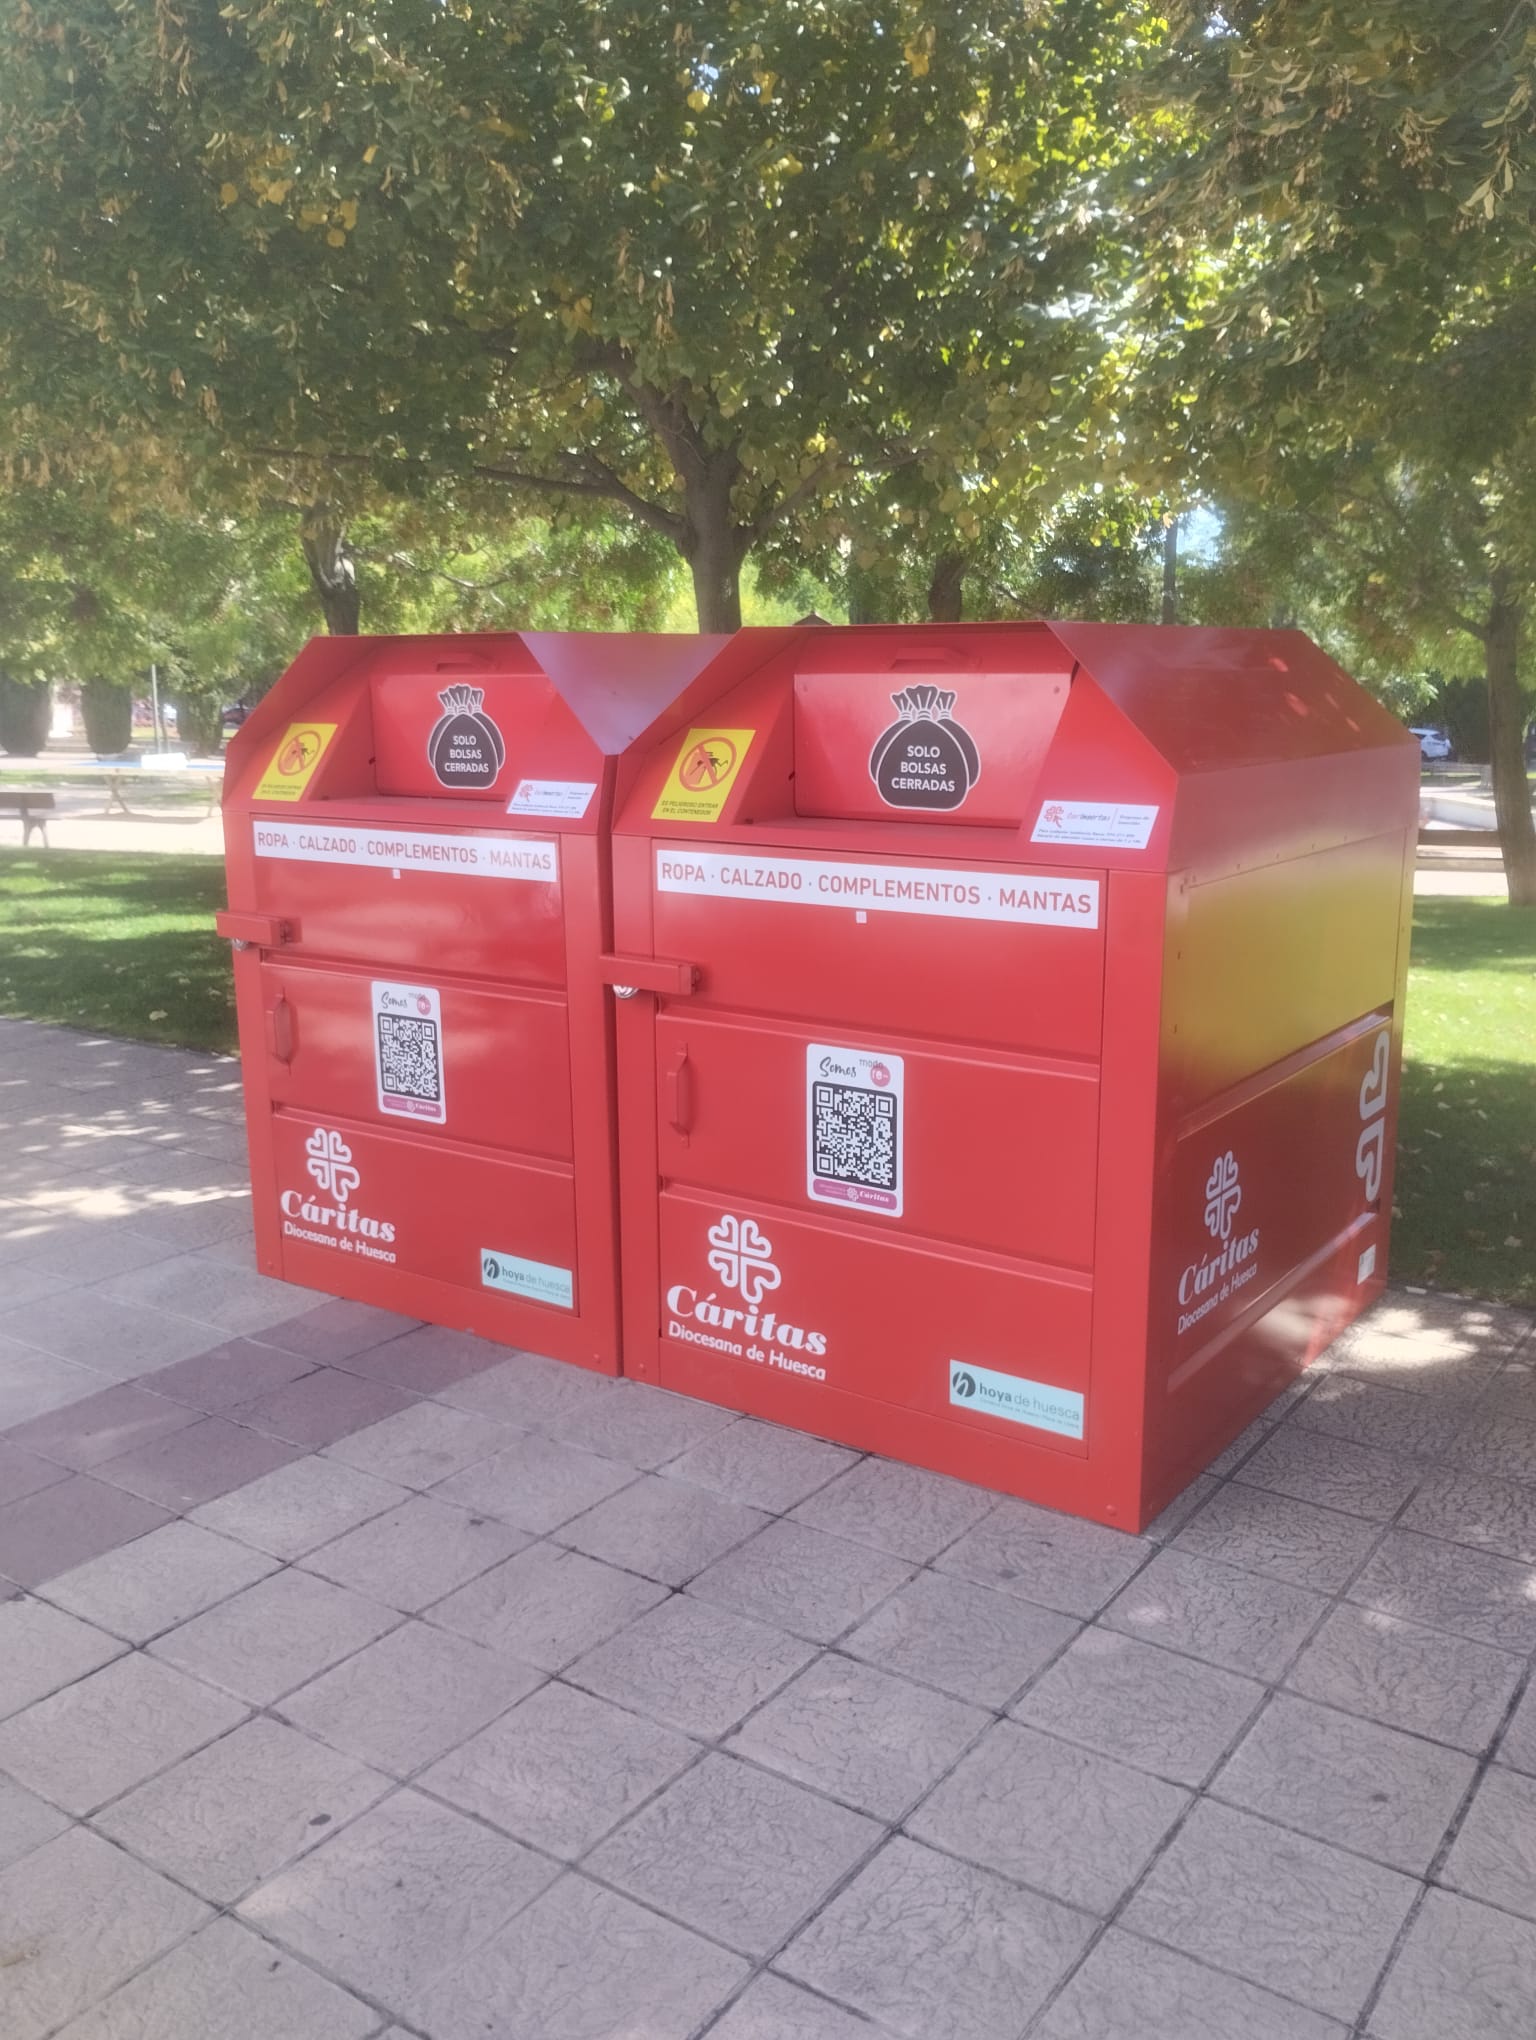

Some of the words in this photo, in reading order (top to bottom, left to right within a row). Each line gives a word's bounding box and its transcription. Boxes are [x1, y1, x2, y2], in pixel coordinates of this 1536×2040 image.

[450, 749, 482, 759] BOLSAS
[453, 735, 477, 746] SOLO
[907, 745, 941, 758] SOLO
[444, 762, 489, 773] CERRADAS
[891, 777, 956, 792] CERRADAS
[900, 761, 947, 775] BOLSAS
[257, 831, 289, 848] ROPA
[299, 835, 357, 854] CALZADO
[367, 840, 479, 864] COMPLEMENTOS
[489, 849, 552, 870] MANTAS
[661, 862, 706, 882] ROPA
[720, 867, 803, 890] CALZADO
[818, 874, 981, 905] COMPLEMENTOS
[999, 888, 1092, 914] MANTAS
[820, 1056, 857, 1078] Somos
[281, 1190, 396, 1243] Cáritas
[284, 1220, 338, 1248] Diocesana
[340, 1236, 353, 1252] de
[356, 1240, 397, 1264] Huesca
[502, 1266, 525, 1281] hoya
[1178, 1228, 1260, 1306] Cáritas
[1178, 1292, 1218, 1336] Diocesana
[1220, 1282, 1230, 1302] de
[1230, 1262, 1258, 1294] Huesca
[666, 1285, 828, 1356] Cáritas
[668, 1320, 742, 1357] Diocesana
[746, 1344, 766, 1362] de
[769, 1349, 826, 1381] Huesca
[980, 1382, 1013, 1403] hoya
[1014, 1393, 1031, 1407] de
[1033, 1397, 1080, 1421] huesca
